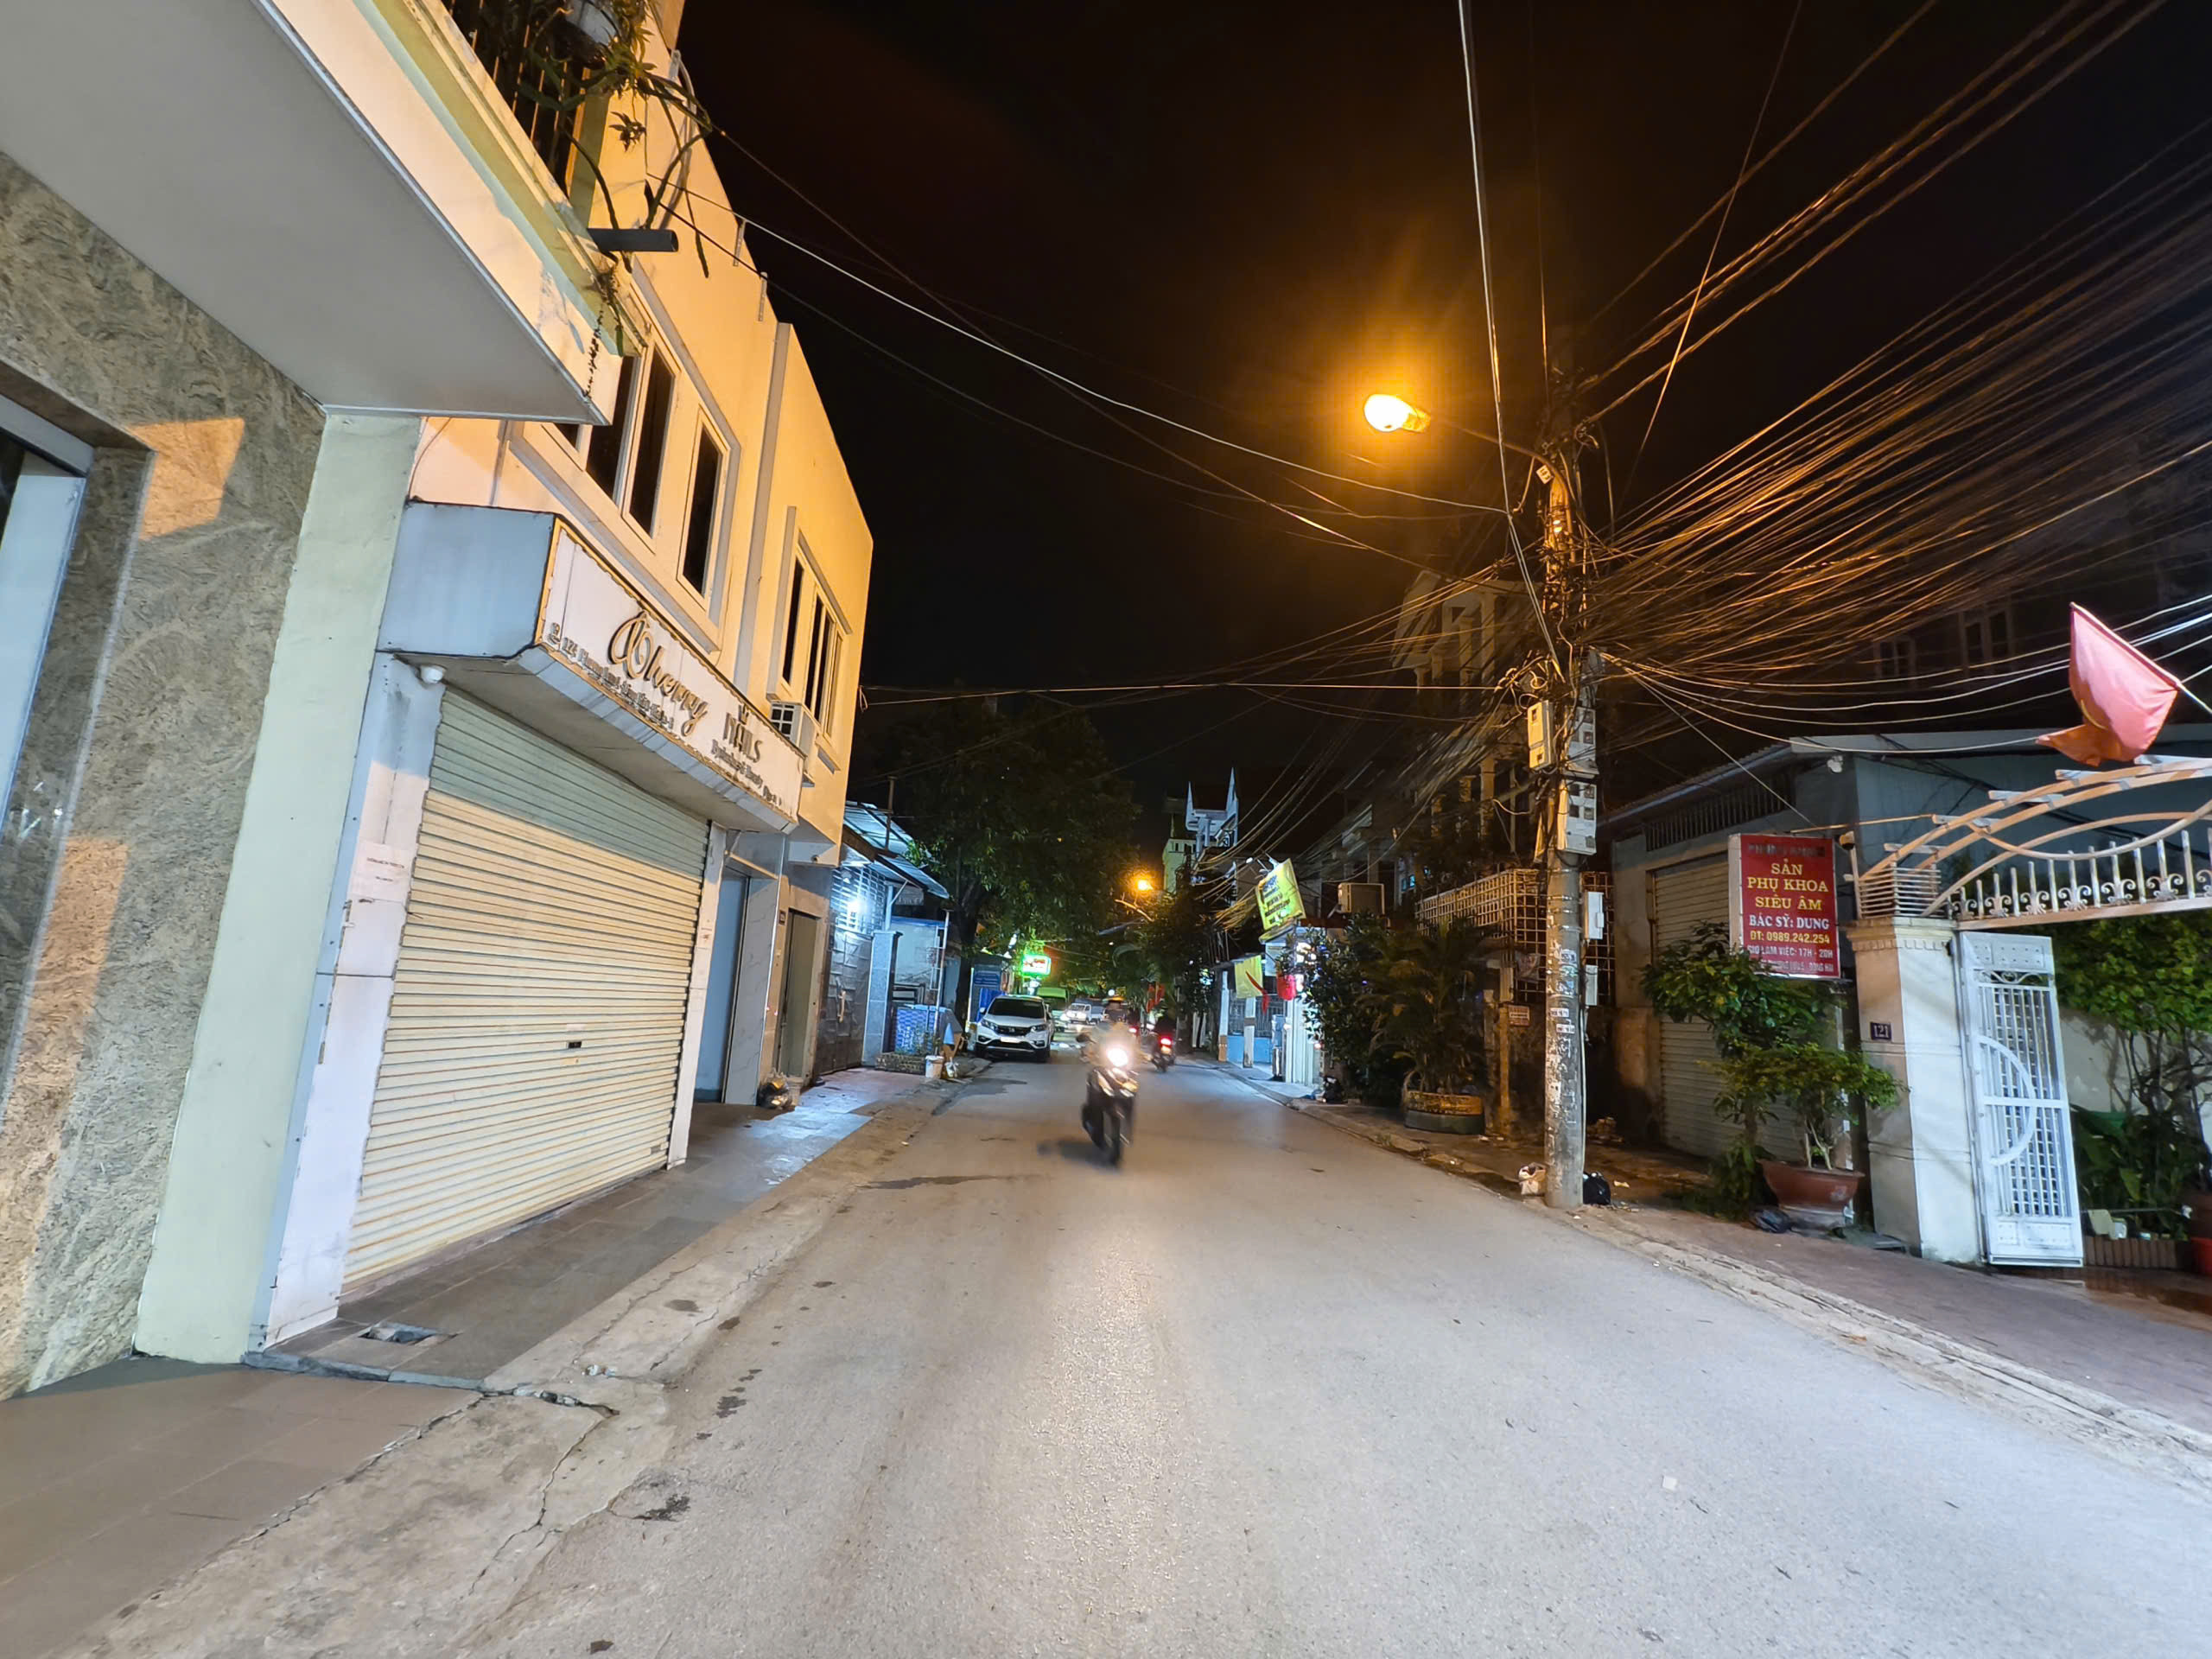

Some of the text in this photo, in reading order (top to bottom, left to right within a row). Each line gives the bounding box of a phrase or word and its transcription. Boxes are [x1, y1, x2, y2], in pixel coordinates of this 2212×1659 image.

[722, 712, 763, 763] NAILS
[1771, 858, 1803, 875] SẢN
[1747, 876, 1828, 893] PHỤ KHOA
[1755, 893, 1822, 911] SIÊU ÂM
[1749, 912, 1773, 927] BÁC
[1796, 917, 1829, 930] DUNG
[1873, 1025, 1889, 1038] 121
